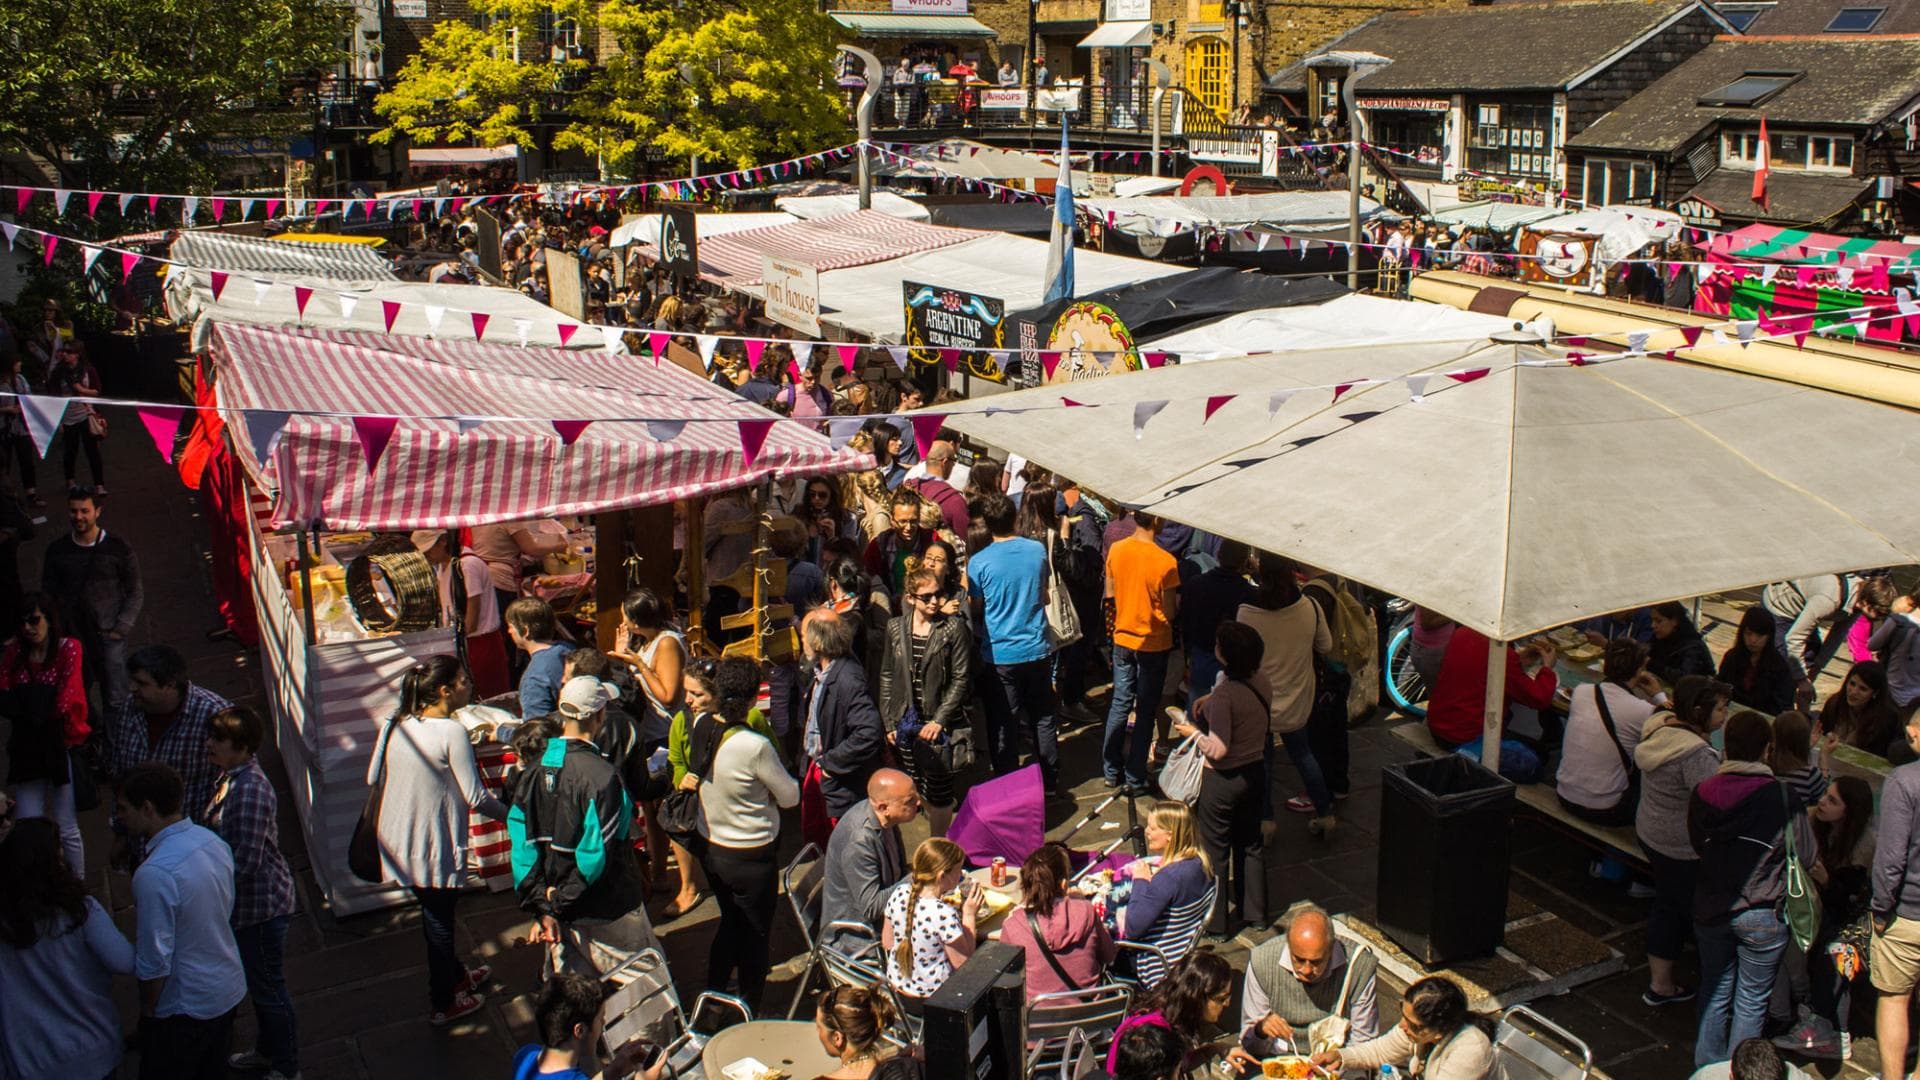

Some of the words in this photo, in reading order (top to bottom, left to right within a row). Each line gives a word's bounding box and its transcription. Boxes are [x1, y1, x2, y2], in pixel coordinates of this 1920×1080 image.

[987, 93, 1021, 101] WHOOPS
[1679, 200, 1715, 218] DVD
[785, 276, 816, 315] house
[925, 308, 982, 340] ARGENTINE
[928, 330, 945, 345] STEAK
